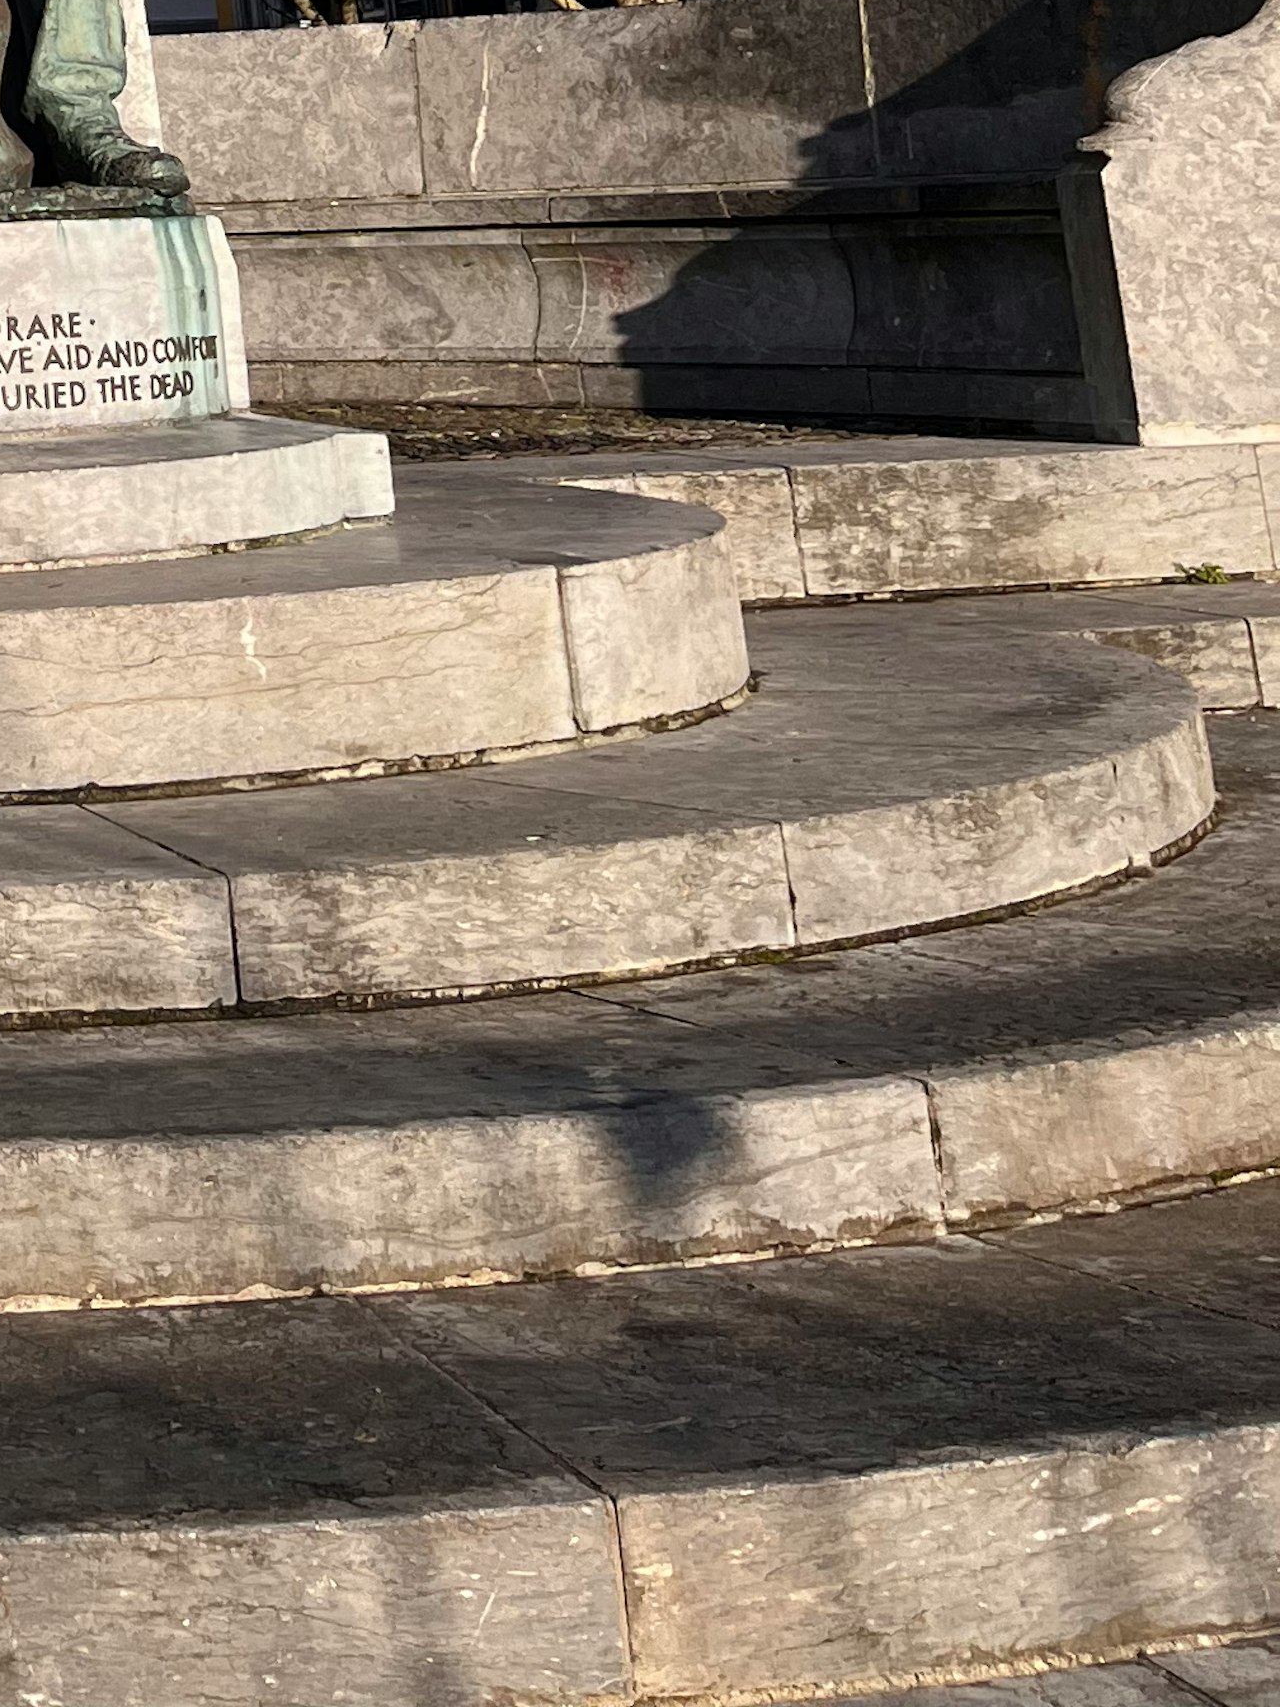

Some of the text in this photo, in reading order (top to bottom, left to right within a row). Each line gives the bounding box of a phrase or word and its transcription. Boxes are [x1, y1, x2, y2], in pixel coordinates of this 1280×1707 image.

[42, 344, 90, 371] AID
[97, 340, 148, 369] AND
[97, 374, 141, 404] THE
[150, 370, 194, 400] DEAD
